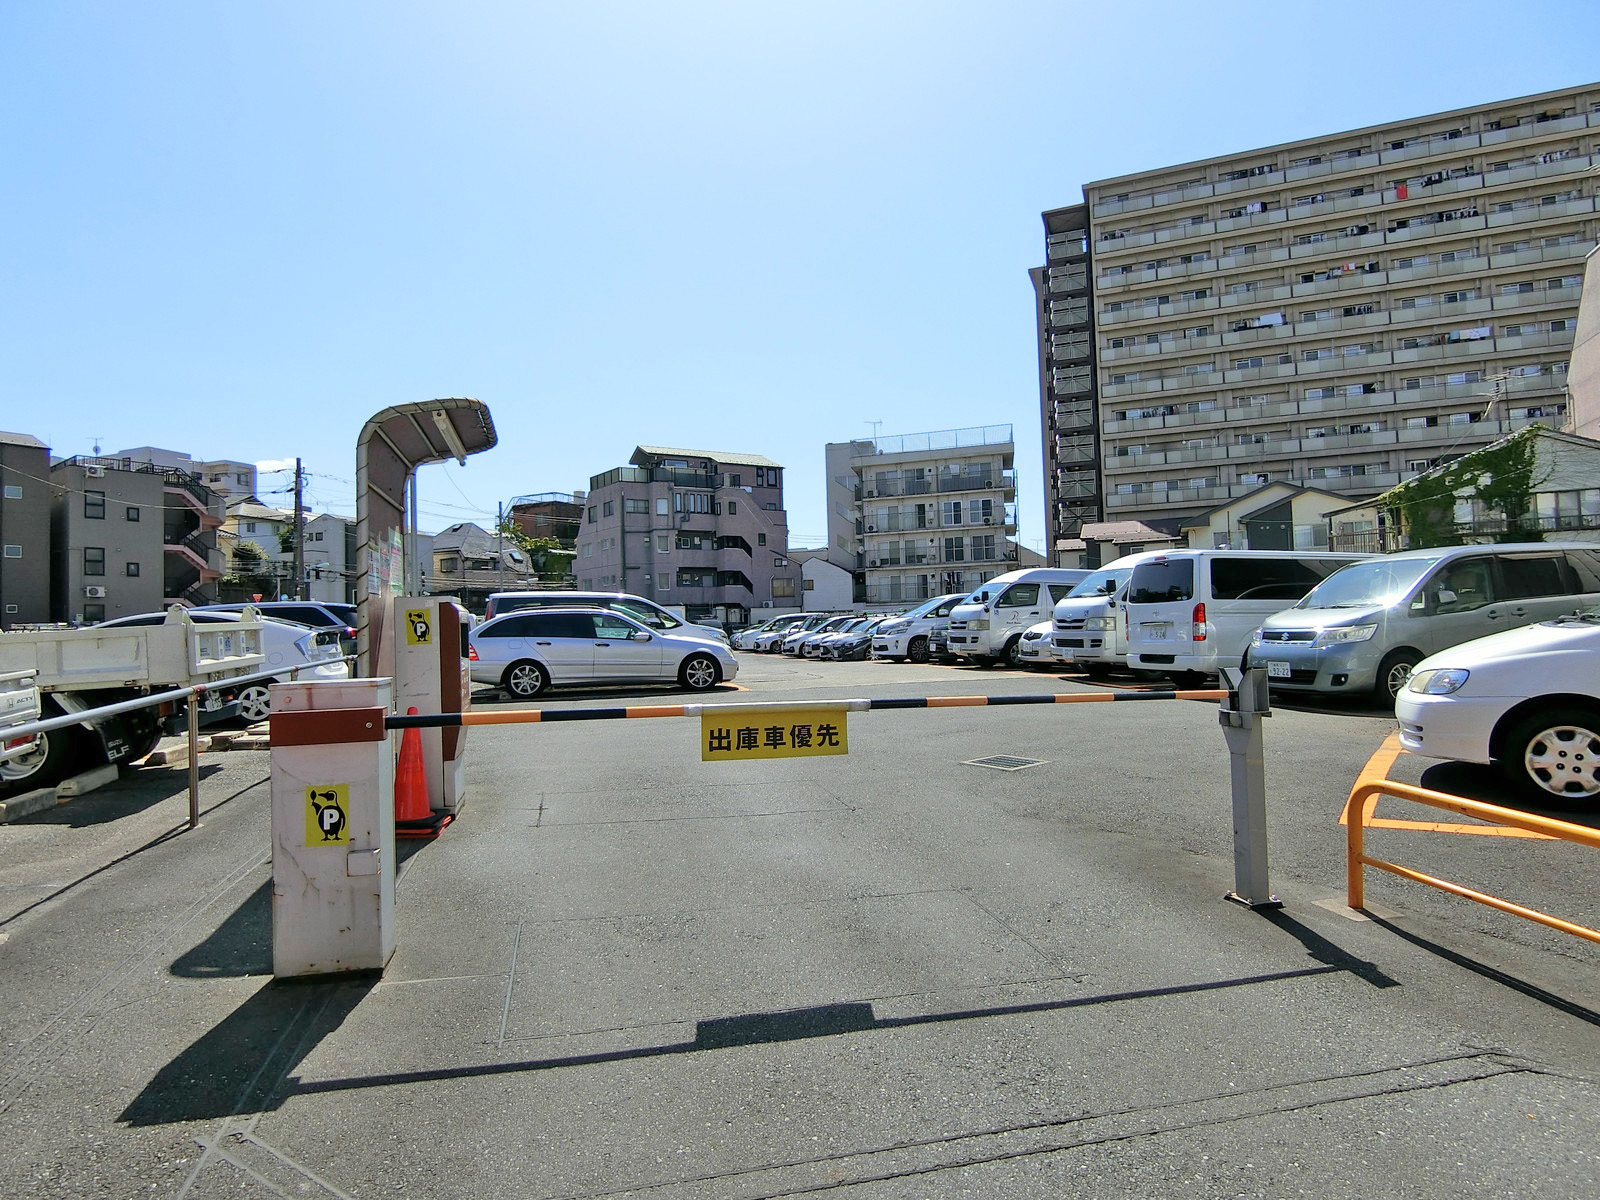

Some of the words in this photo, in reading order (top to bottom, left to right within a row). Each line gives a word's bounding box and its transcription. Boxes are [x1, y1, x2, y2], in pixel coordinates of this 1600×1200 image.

[16, 695, 34, 704] ACTY
[107, 738, 123, 748] ISUZU
[708, 723, 840, 753] 出庫車優先
[107, 744, 131, 760] ELF
[323, 808, 340, 830] P
